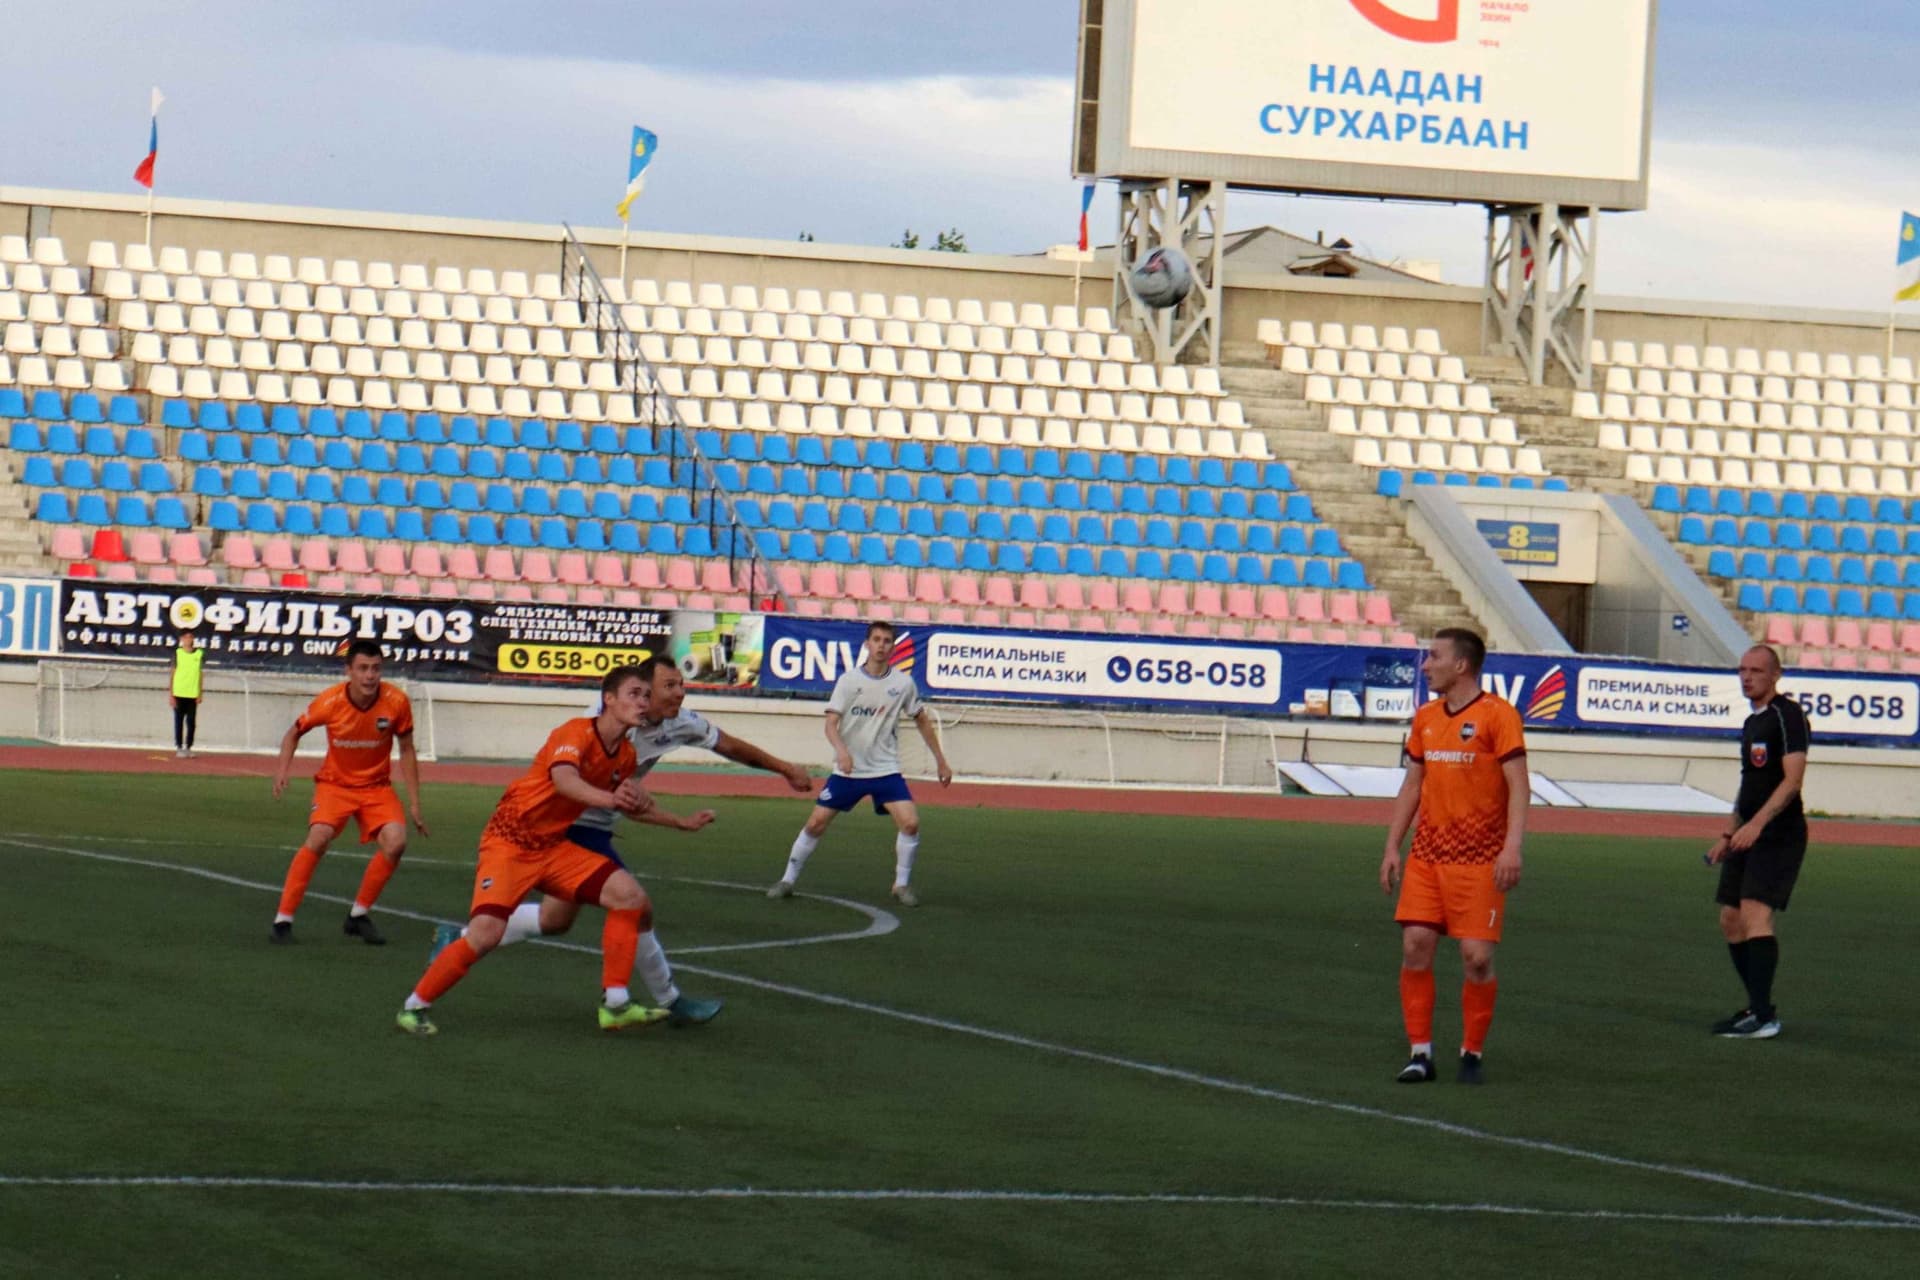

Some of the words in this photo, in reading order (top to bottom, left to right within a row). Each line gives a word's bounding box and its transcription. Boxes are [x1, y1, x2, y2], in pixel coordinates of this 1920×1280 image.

[1309, 63, 1483, 107] НААДАН
[1259, 103, 1529, 150] СУРХАРБААН
[1508, 524, 1529, 548] 8
[495, 606, 572, 620] ФИЛЬТРЫ,
[577, 610, 626, 623] МАСЛА
[630, 612, 660, 624] ДЛЯ
[480, 616, 592, 631] СПЕЦТЕХНИКИ,
[596, 622, 673, 635] ГРУЗОВЫХ
[67, 627, 221, 650] официальый
[228, 638, 294, 656] дилер
[303, 639, 337, 656] GNV
[509, 629, 520, 640] И
[524, 630, 601, 643] ЛЕГКОВЫХ
[605, 634, 644, 645] АВТО
[770, 637, 869, 682] GNV
[938, 645, 1066, 663] ПРЕМИАЛЬНЫЕ
[937, 664, 996, 678] МАСЛА
[1002, 667, 1013, 680] И
[1018, 668, 1086, 683] СМАЗКИ
[1136, 658, 1266, 688] 658-058
[1588, 679, 1709, 697] ПРЕМИАЛЬНЫЕ
[851, 706, 878, 717] GNV
[1587, 698, 1644, 712] МАСЛА
[1649, 701, 1660, 713] И
[1664, 702, 1730, 716] СМАЗКИ
